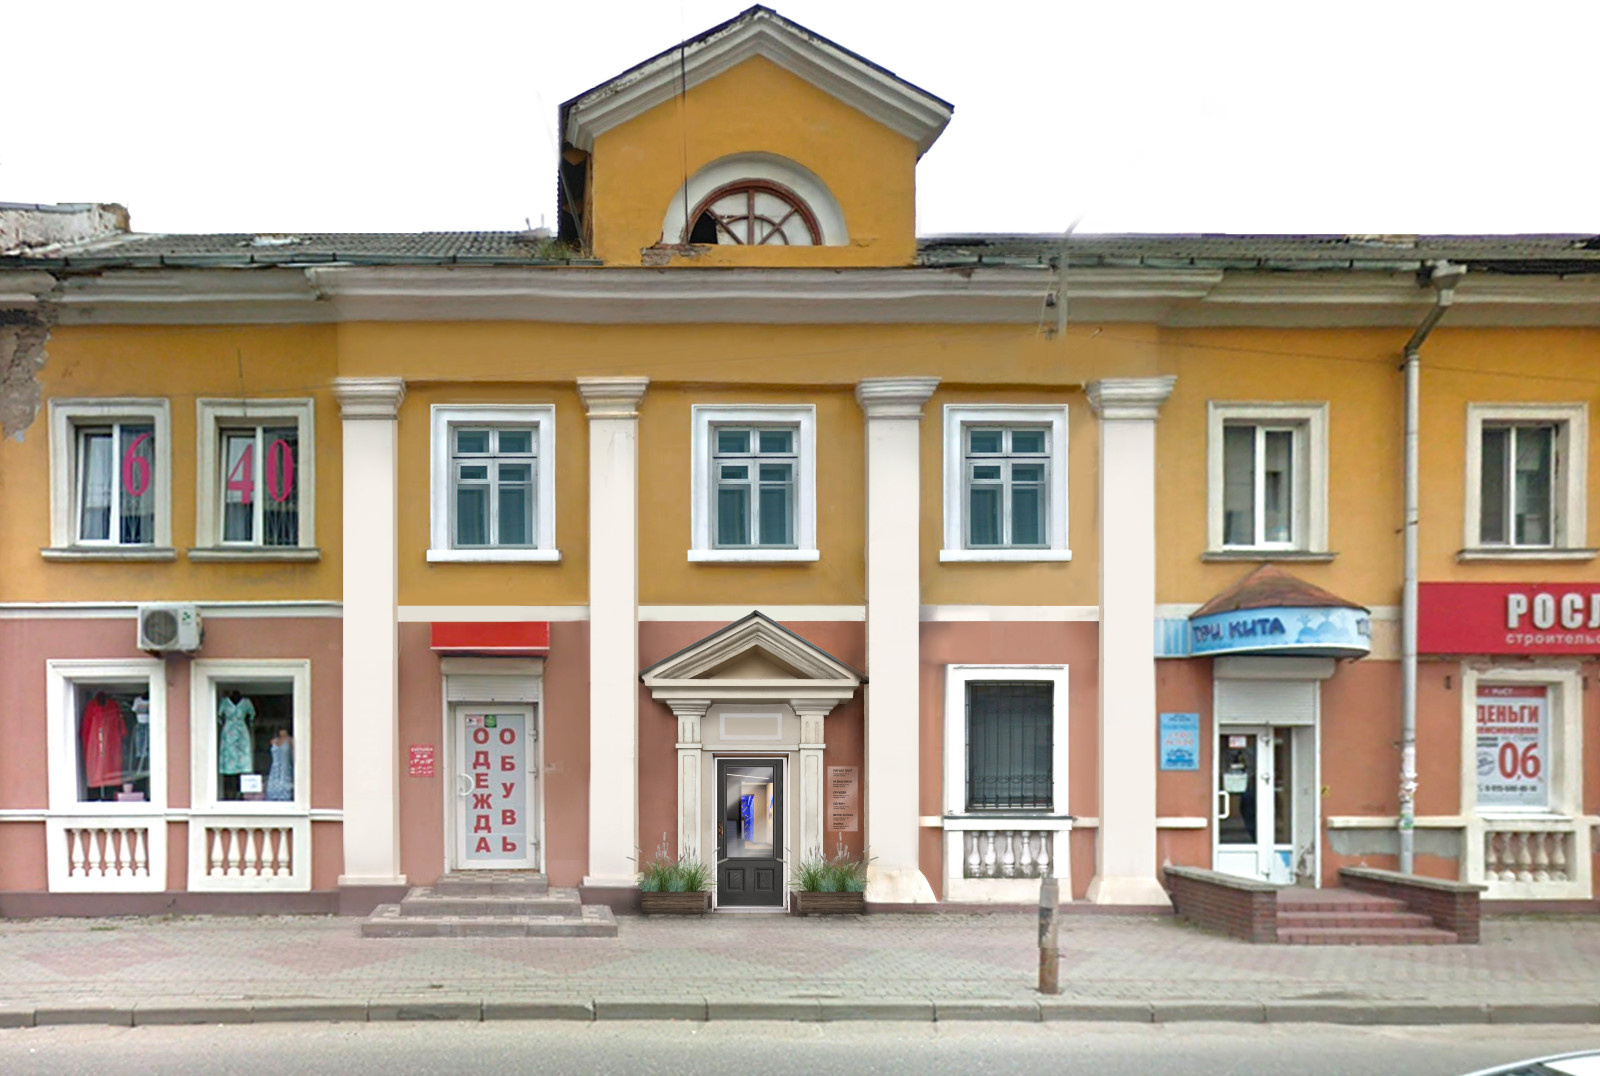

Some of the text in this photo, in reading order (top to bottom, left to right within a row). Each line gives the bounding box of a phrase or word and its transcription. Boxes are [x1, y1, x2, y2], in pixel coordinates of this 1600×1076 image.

[122, 432, 151, 497] 6
[1228, 617, 1286, 639] КИТА
[1477, 705, 1539, 724] ДЕНЬГИ
[472, 728, 493, 853] ОДЕЖДА
[499, 728, 518, 853] ОБУВЬ
